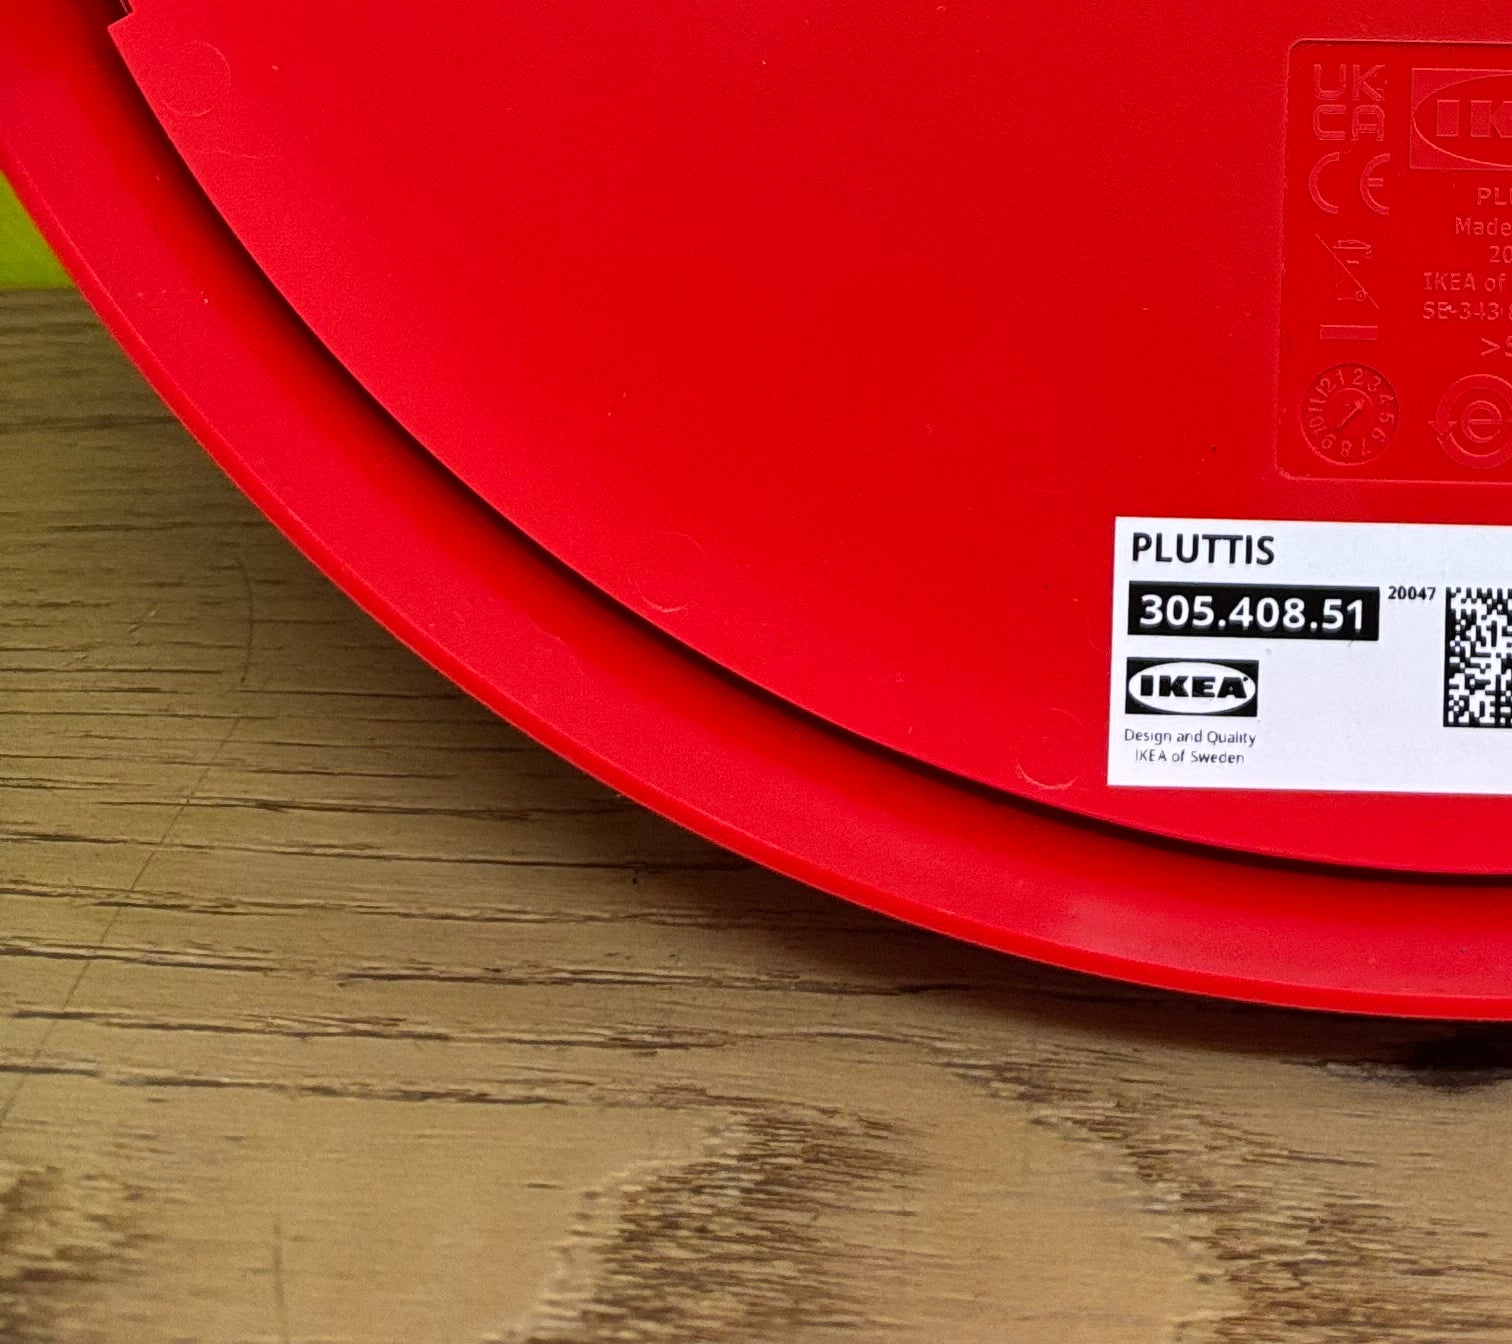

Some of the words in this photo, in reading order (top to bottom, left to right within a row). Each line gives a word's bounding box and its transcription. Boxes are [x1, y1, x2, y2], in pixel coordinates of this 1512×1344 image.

[1313, 64, 1386, 101] UK
[1455, 216, 1512, 237] Made
[1423, 271, 1476, 291] IKEA
[1484, 273, 1506, 292] of
[1132, 531, 1275, 565] PLUTTIS
[1387, 585, 1437, 601] 20047
[1139, 593, 1363, 633] 305.408.51
[1124, 728, 1172, 746] Design
[1176, 729, 1202, 743] and
[1207, 731, 1256, 747] Quality
[1135, 749, 1167, 762] IKEA
[1171, 749, 1185, 763] of
[1190, 751, 1245, 764] Sweden
